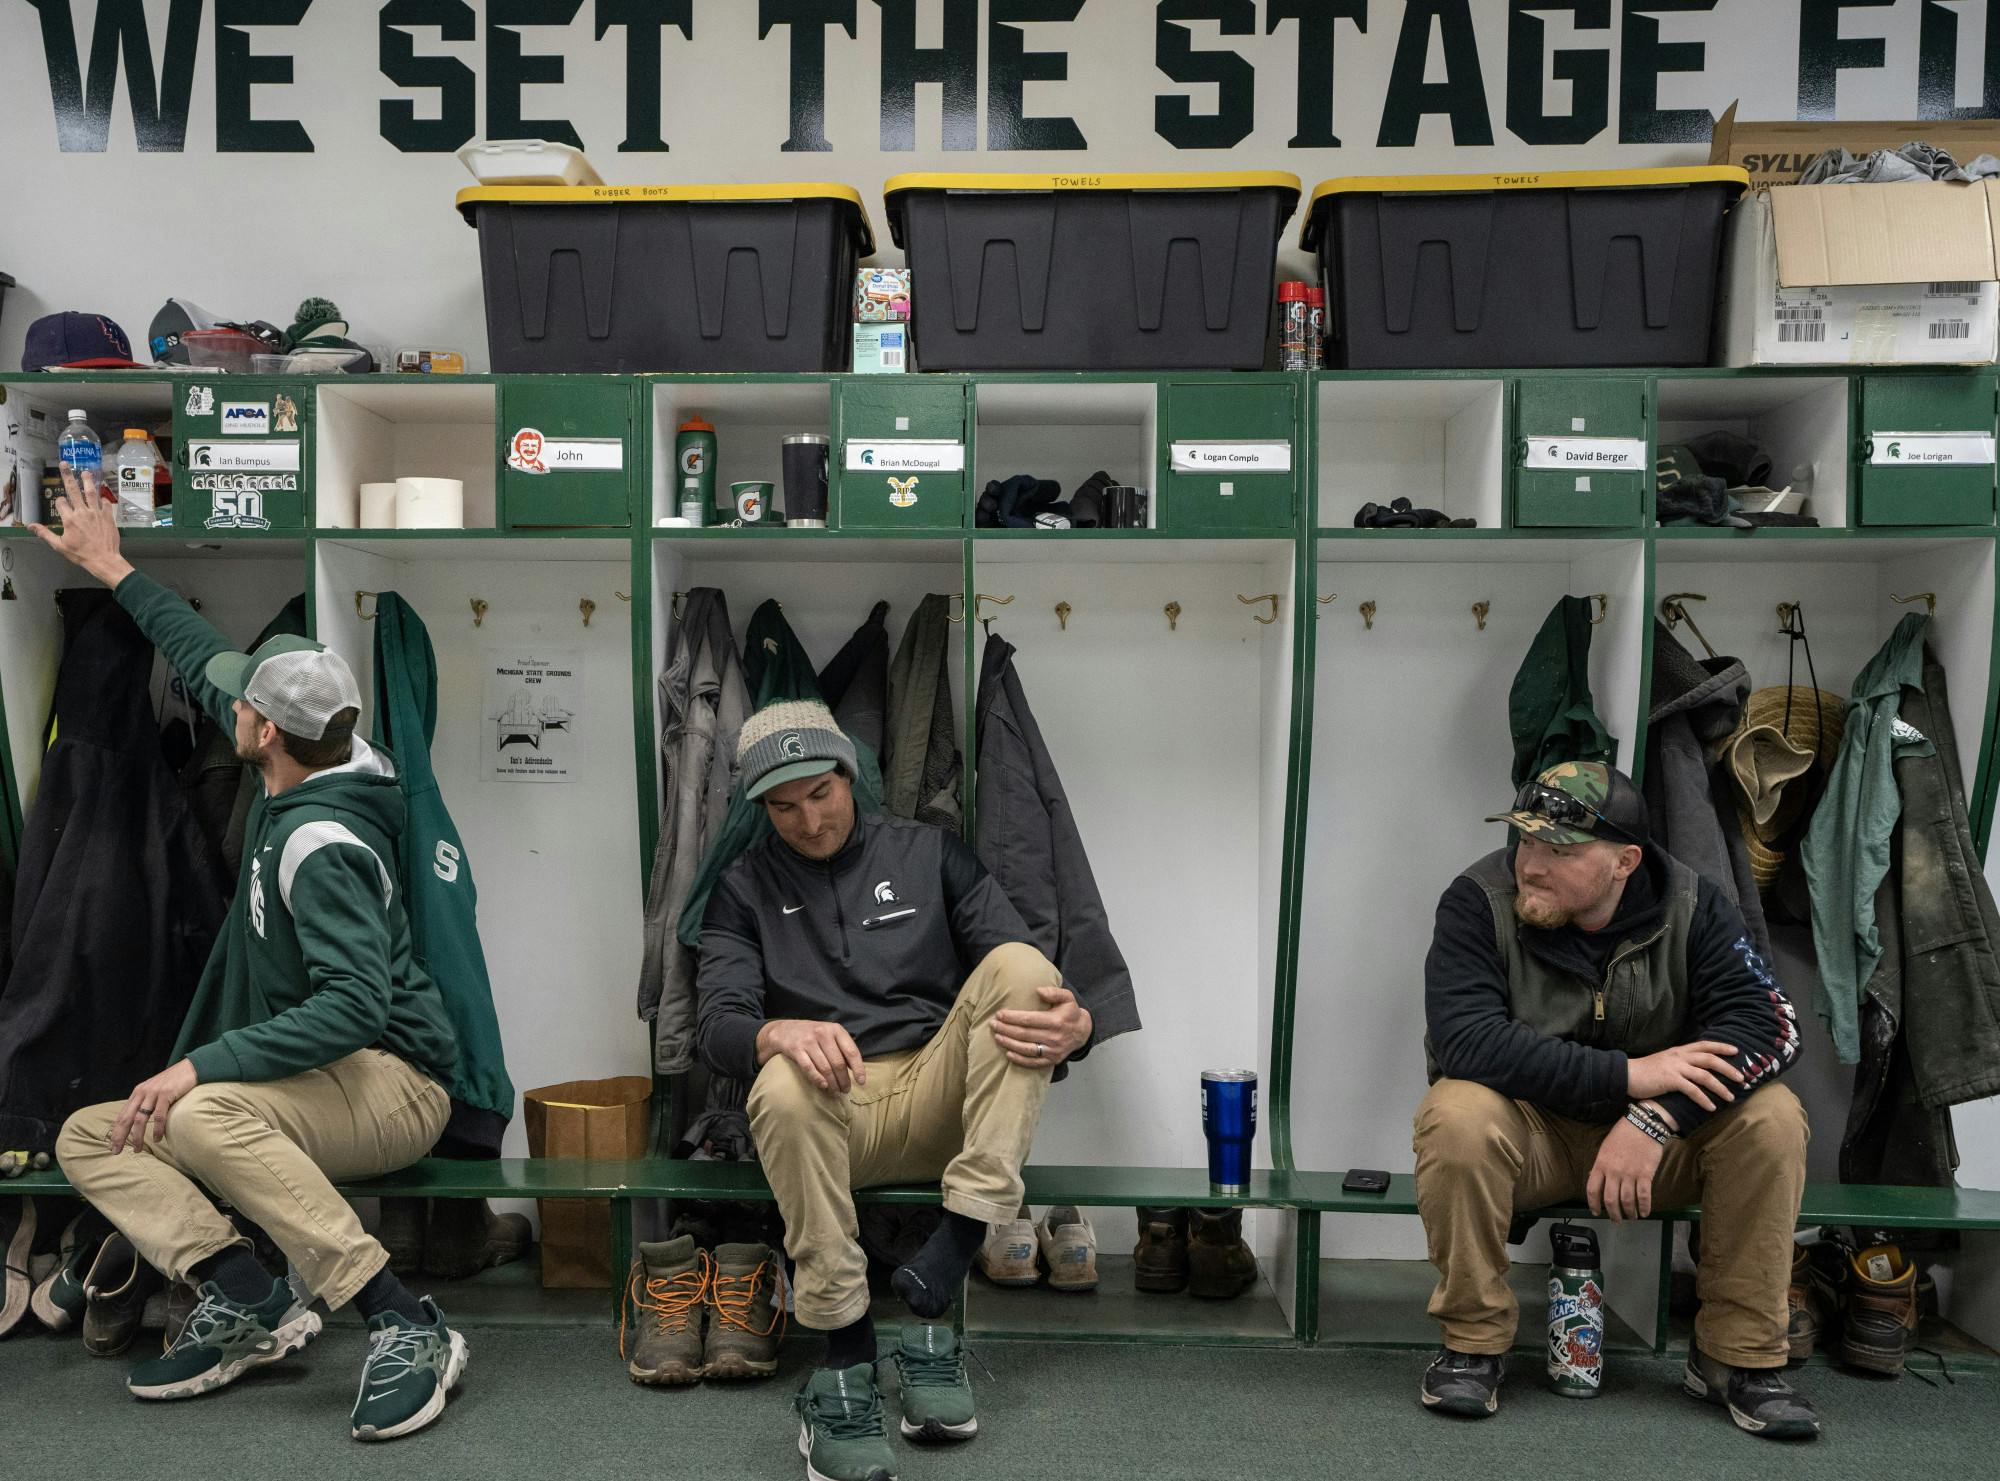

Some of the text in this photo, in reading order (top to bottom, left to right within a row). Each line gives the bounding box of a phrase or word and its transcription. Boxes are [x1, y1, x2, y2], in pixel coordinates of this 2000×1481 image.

[26, 0, 315, 152] WE
[379, 0, 693, 152] SET
[758, 0, 1087, 152] THE
[1155, 0, 1719, 149] STAGE
[1052, 177, 1102, 187] TOWELS
[1493, 175, 1540, 185] TOWELS
[593, 187, 669, 197] RUBBER BOOTS
[62, 447, 96, 458] AQUAFINA
[556, 450, 583, 461] John
[1566, 452, 1629, 463] David Berger
[1907, 452, 1953, 462] Joe Lorigan
[219, 457, 271, 467] Ian Bumpus
[1203, 453, 1259, 463] Logan Complo
[880, 458, 941, 469] Brian McDougal
[433, 838, 460, 882] S
